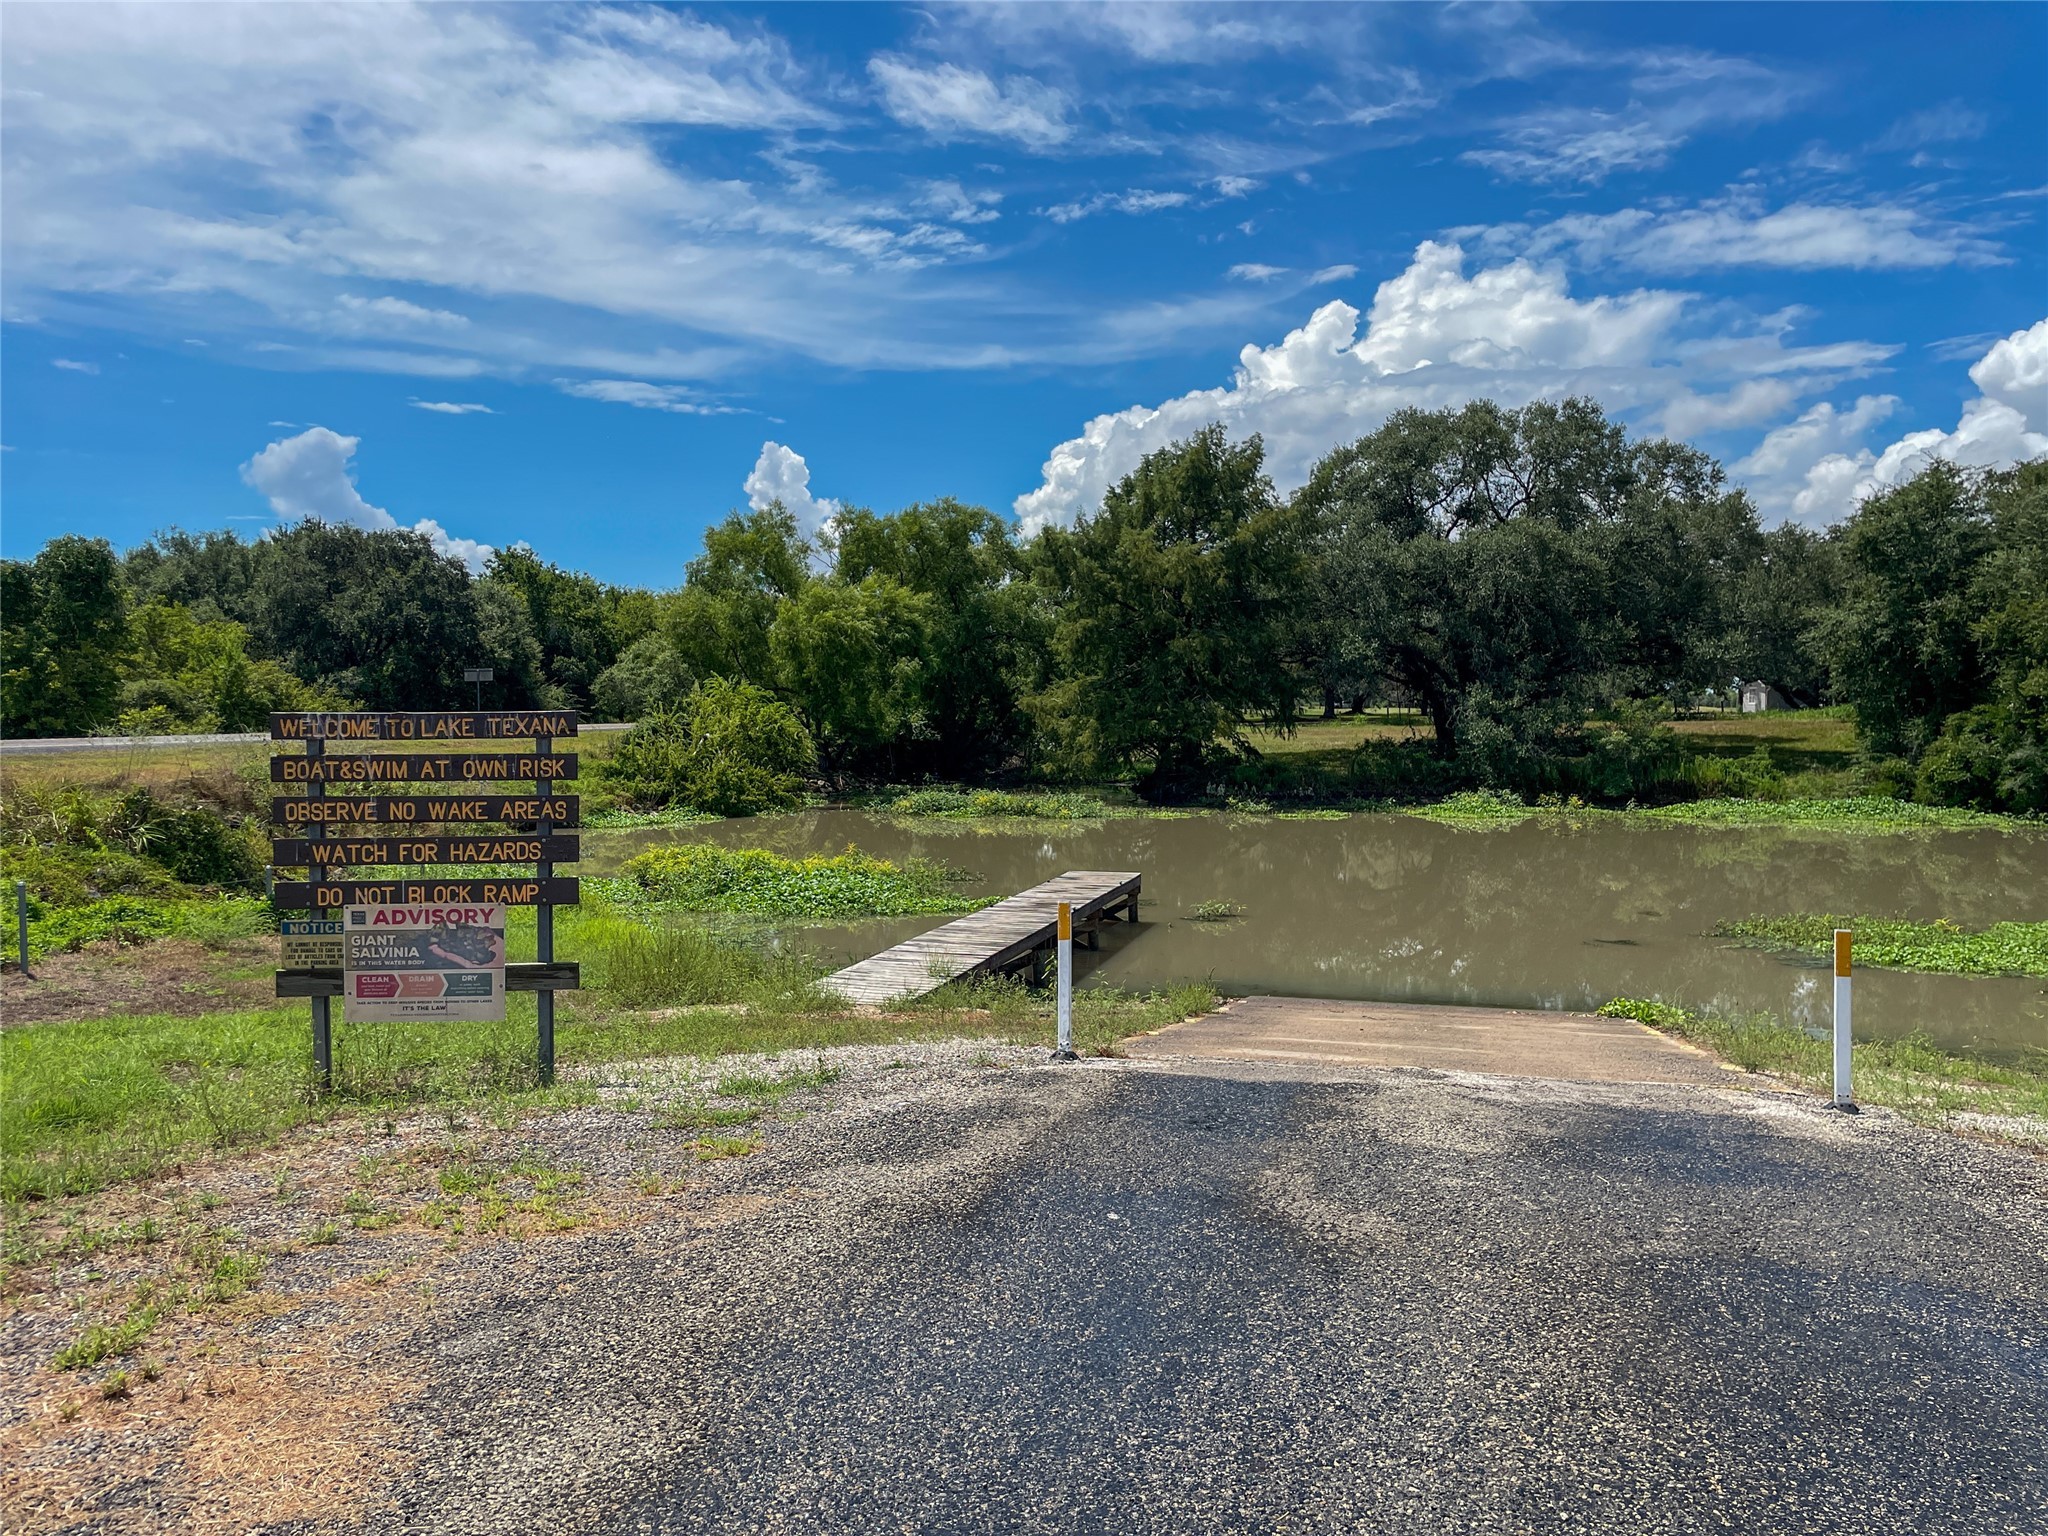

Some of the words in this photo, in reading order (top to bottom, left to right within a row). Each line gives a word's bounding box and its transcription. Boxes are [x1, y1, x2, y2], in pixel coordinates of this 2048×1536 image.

[279, 718, 379, 737] WELCOME
[386, 718, 414, 737] TO
[420, 718, 475, 737] LAKE
[487, 717, 570, 736] TEXANA
[283, 760, 408, 779] BOAT&SWIM
[420, 760, 450, 778] AT
[463, 759, 507, 778] OWN
[519, 759, 565, 777] RISK
[285, 802, 378, 821] OBSERVE
[389, 802, 416, 820] NO
[428, 801, 488, 820] WAKE
[500, 801, 567, 819] AREAS
[312, 844, 388, 863] WATCH
[400, 843, 438, 862] FOR
[450, 842, 542, 861] HAZARDS
[317, 887, 343, 906] DO
[355, 886, 396, 905] NOT
[408, 885, 472, 904] BLOCK
[483, 884, 539, 903] RAMP
[372, 908, 495, 925] ADVISORY
[289, 922, 343, 934] NOTICE
[351, 935, 396, 946] GIANT
[351, 947, 420, 958] SALVINIA
